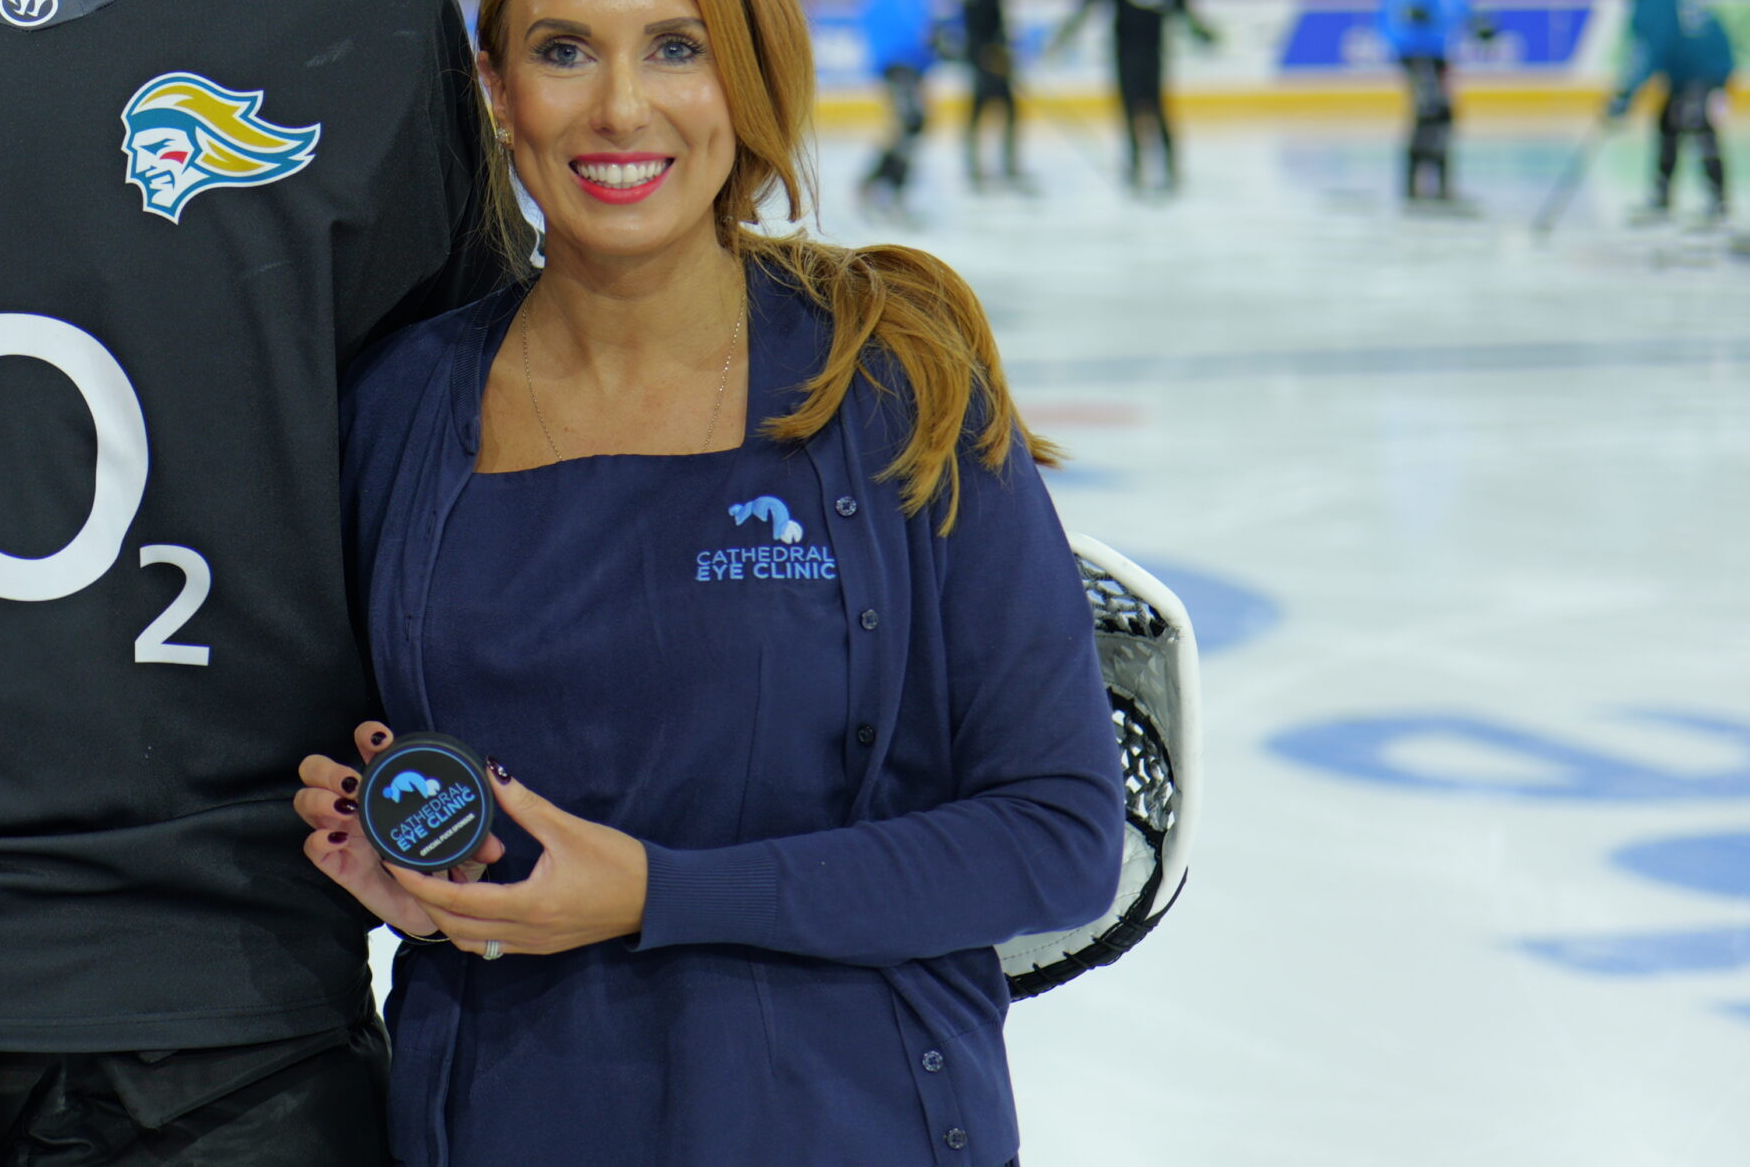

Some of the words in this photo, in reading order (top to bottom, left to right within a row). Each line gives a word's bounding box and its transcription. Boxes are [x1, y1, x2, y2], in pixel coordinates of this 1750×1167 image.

[696, 564, 744, 581] EYE
[753, 562, 836, 579] CLINIC
[697, 546, 835, 566] CATHEDRAL
[390, 782, 468, 840] CATHEDRAL
[397, 824, 428, 852] EYE
[427, 789, 476, 828] CLINIC
